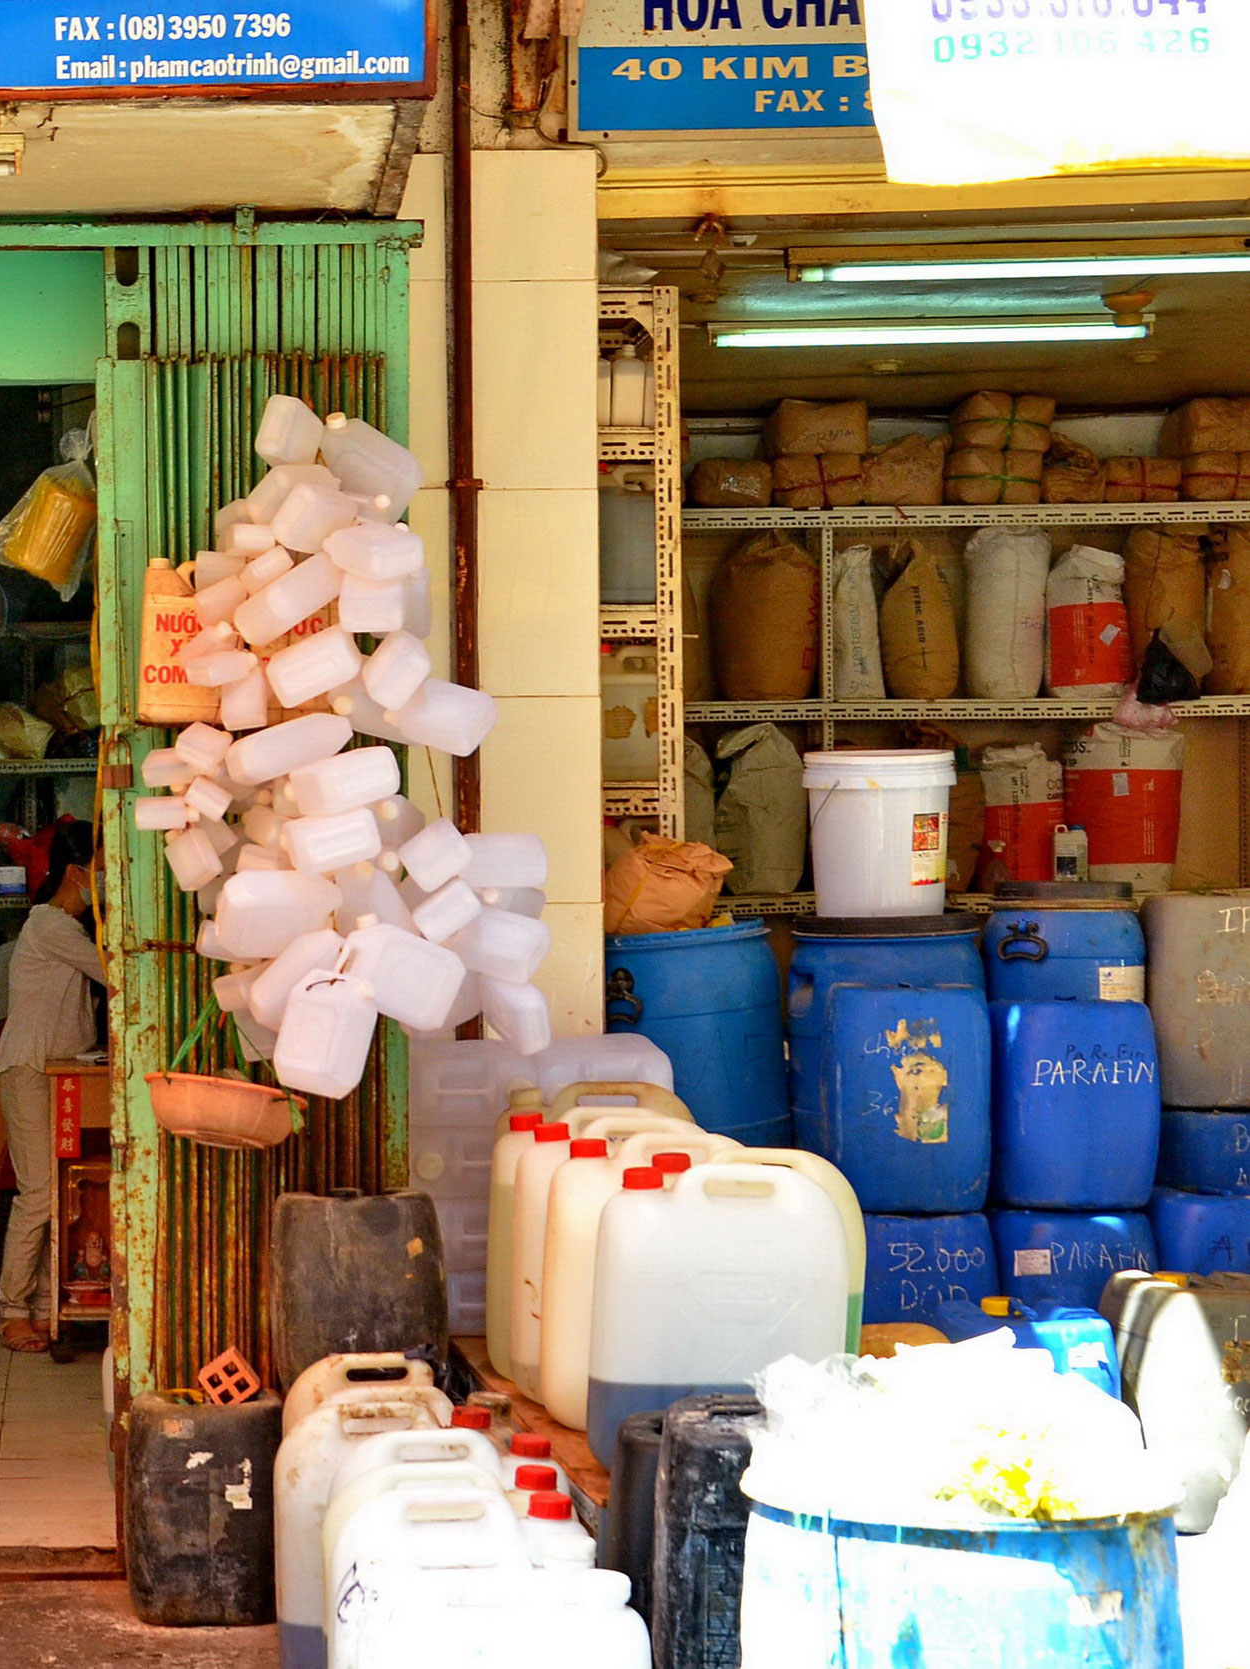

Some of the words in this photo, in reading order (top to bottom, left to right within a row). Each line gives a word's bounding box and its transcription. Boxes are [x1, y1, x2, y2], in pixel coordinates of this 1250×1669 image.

[55, 16, 101, 41] FAX
[119, 14, 165, 41] (08)
[169, 14, 226, 40] 3950
[233, 13, 292, 38] 7396
[933, 30, 1036, 63] 0932
[1136, 27, 1210, 54] 426
[55, 54, 116, 80] Email
[130, 50, 410, 83] phamcaotrinh@gmail.com
[611, 57, 683, 81] 40
[702, 56, 809, 80] KIM
[754, 89, 825, 113] FAX
